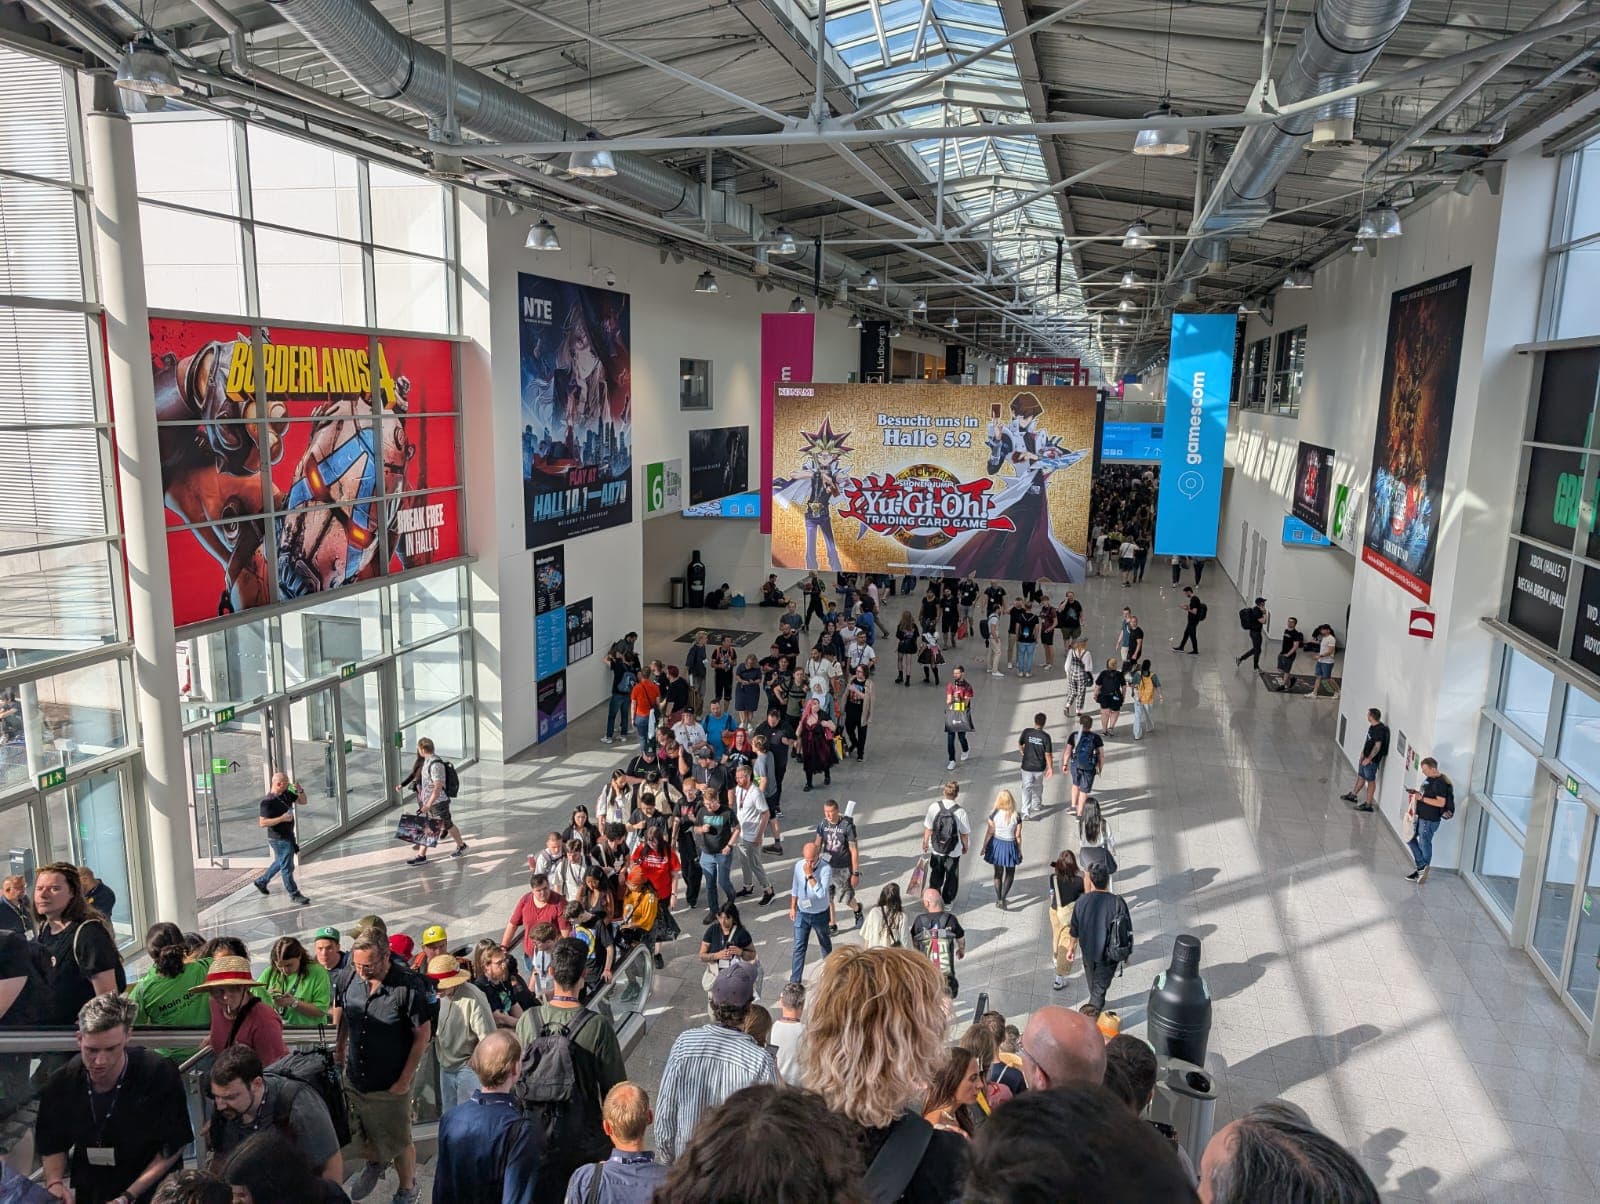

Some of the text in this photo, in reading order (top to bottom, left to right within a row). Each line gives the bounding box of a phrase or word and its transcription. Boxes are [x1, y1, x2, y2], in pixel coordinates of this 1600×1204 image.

[524, 296, 552, 319] NTE
[877, 325, 886, 368] Lindbergh
[877, 413, 979, 428] Besucht uns in
[1187, 371, 1206, 465] gamescom
[883, 428, 971, 448] Halle 5.2
[569, 466, 597, 486] PLAY AT
[533, 490, 565, 523] HALL
[653, 475, 662, 510] 6
[861, 489, 994, 519] Yu-Gi-Oh!
[397, 503, 445, 534] BREAK FREE
[865, 515, 988, 530] TRADING CARD GAME
[405, 532, 414, 557] IN
[415, 529, 433, 555] HALL
[1530, 554, 1567, 582] XBOX (HALLE 7)
[1517, 575, 1534, 594] MECHA
[1533, 583, 1550, 602] BREAK
[159, 998, 181, 1012] Main
